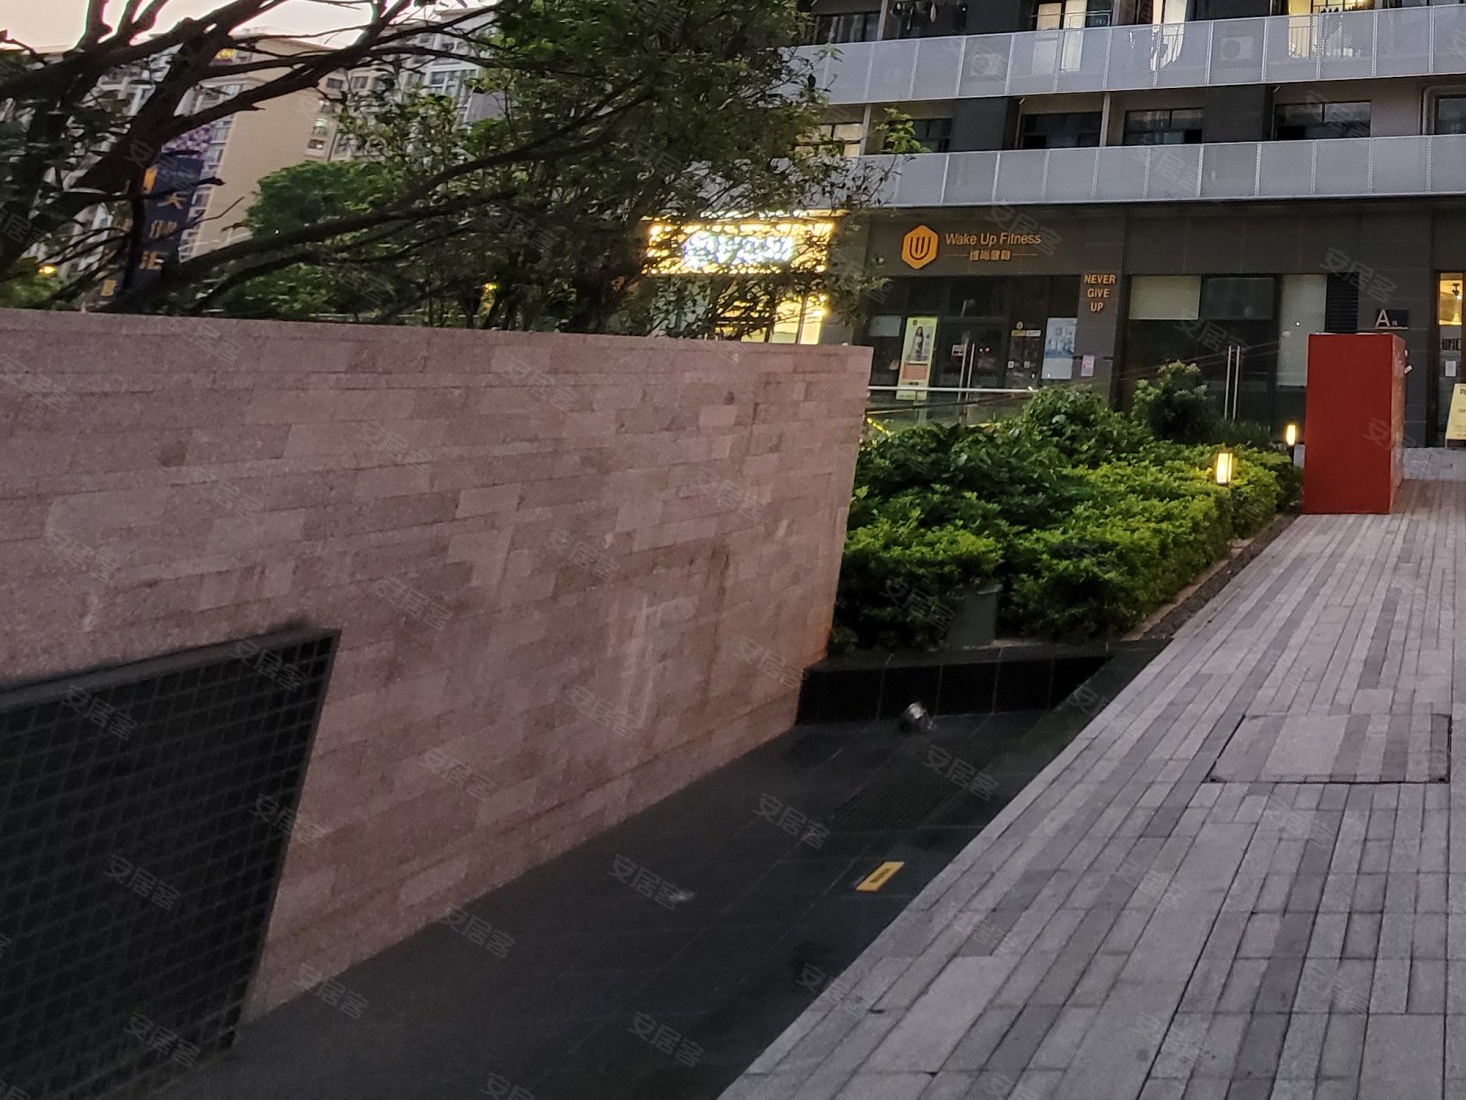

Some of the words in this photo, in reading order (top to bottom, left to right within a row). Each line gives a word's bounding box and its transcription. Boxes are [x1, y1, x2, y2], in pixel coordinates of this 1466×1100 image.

[946, 233, 976, 245] Wake
[980, 233, 997, 247] Up
[1000, 232, 1042, 245] Fitness
[1084, 274, 1116, 285] NEVER
[1087, 288, 1110, 298] GIVE
[1090, 302, 1104, 313] UP
[1375, 309, 1391, 327] A
